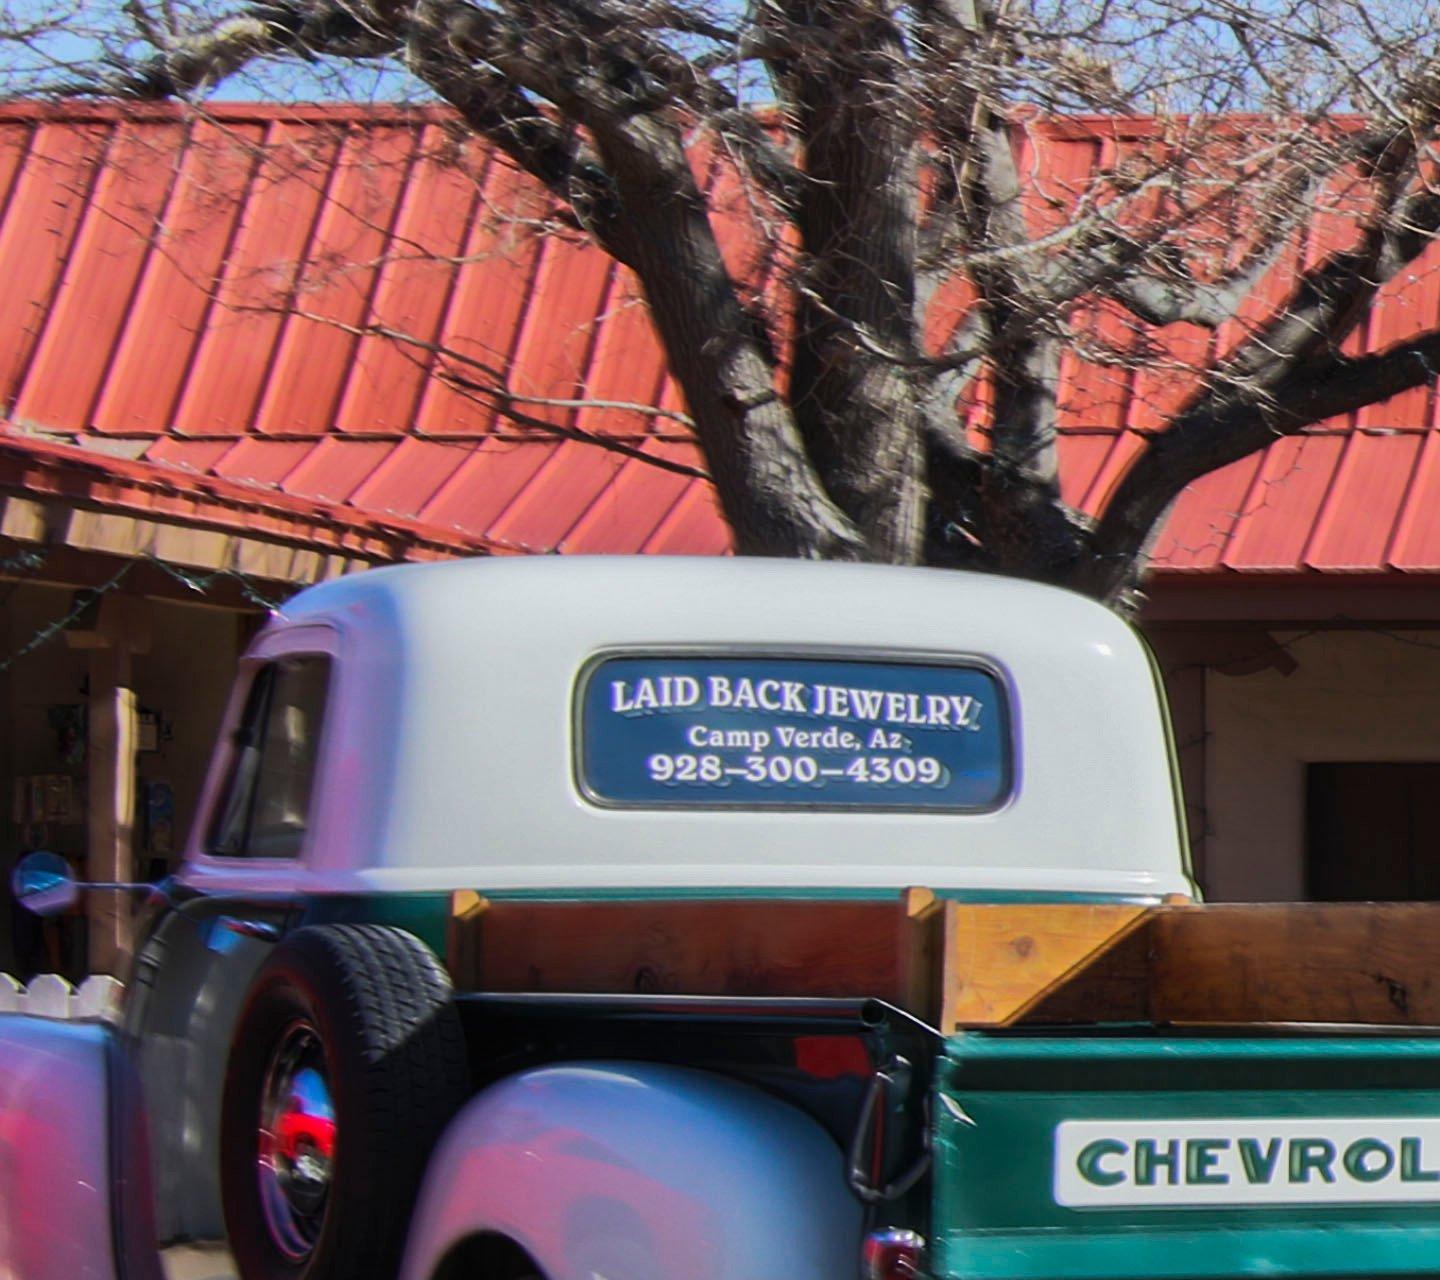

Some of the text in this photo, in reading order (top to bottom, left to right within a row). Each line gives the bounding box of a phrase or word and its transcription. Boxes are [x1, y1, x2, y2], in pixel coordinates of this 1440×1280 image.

[610, 676, 975, 726] LAID BACK JEWELRY
[689, 726, 770, 752] Camp
[775, 726, 861, 751] Verde,
[650, 754, 942, 784] 928-300-4309
